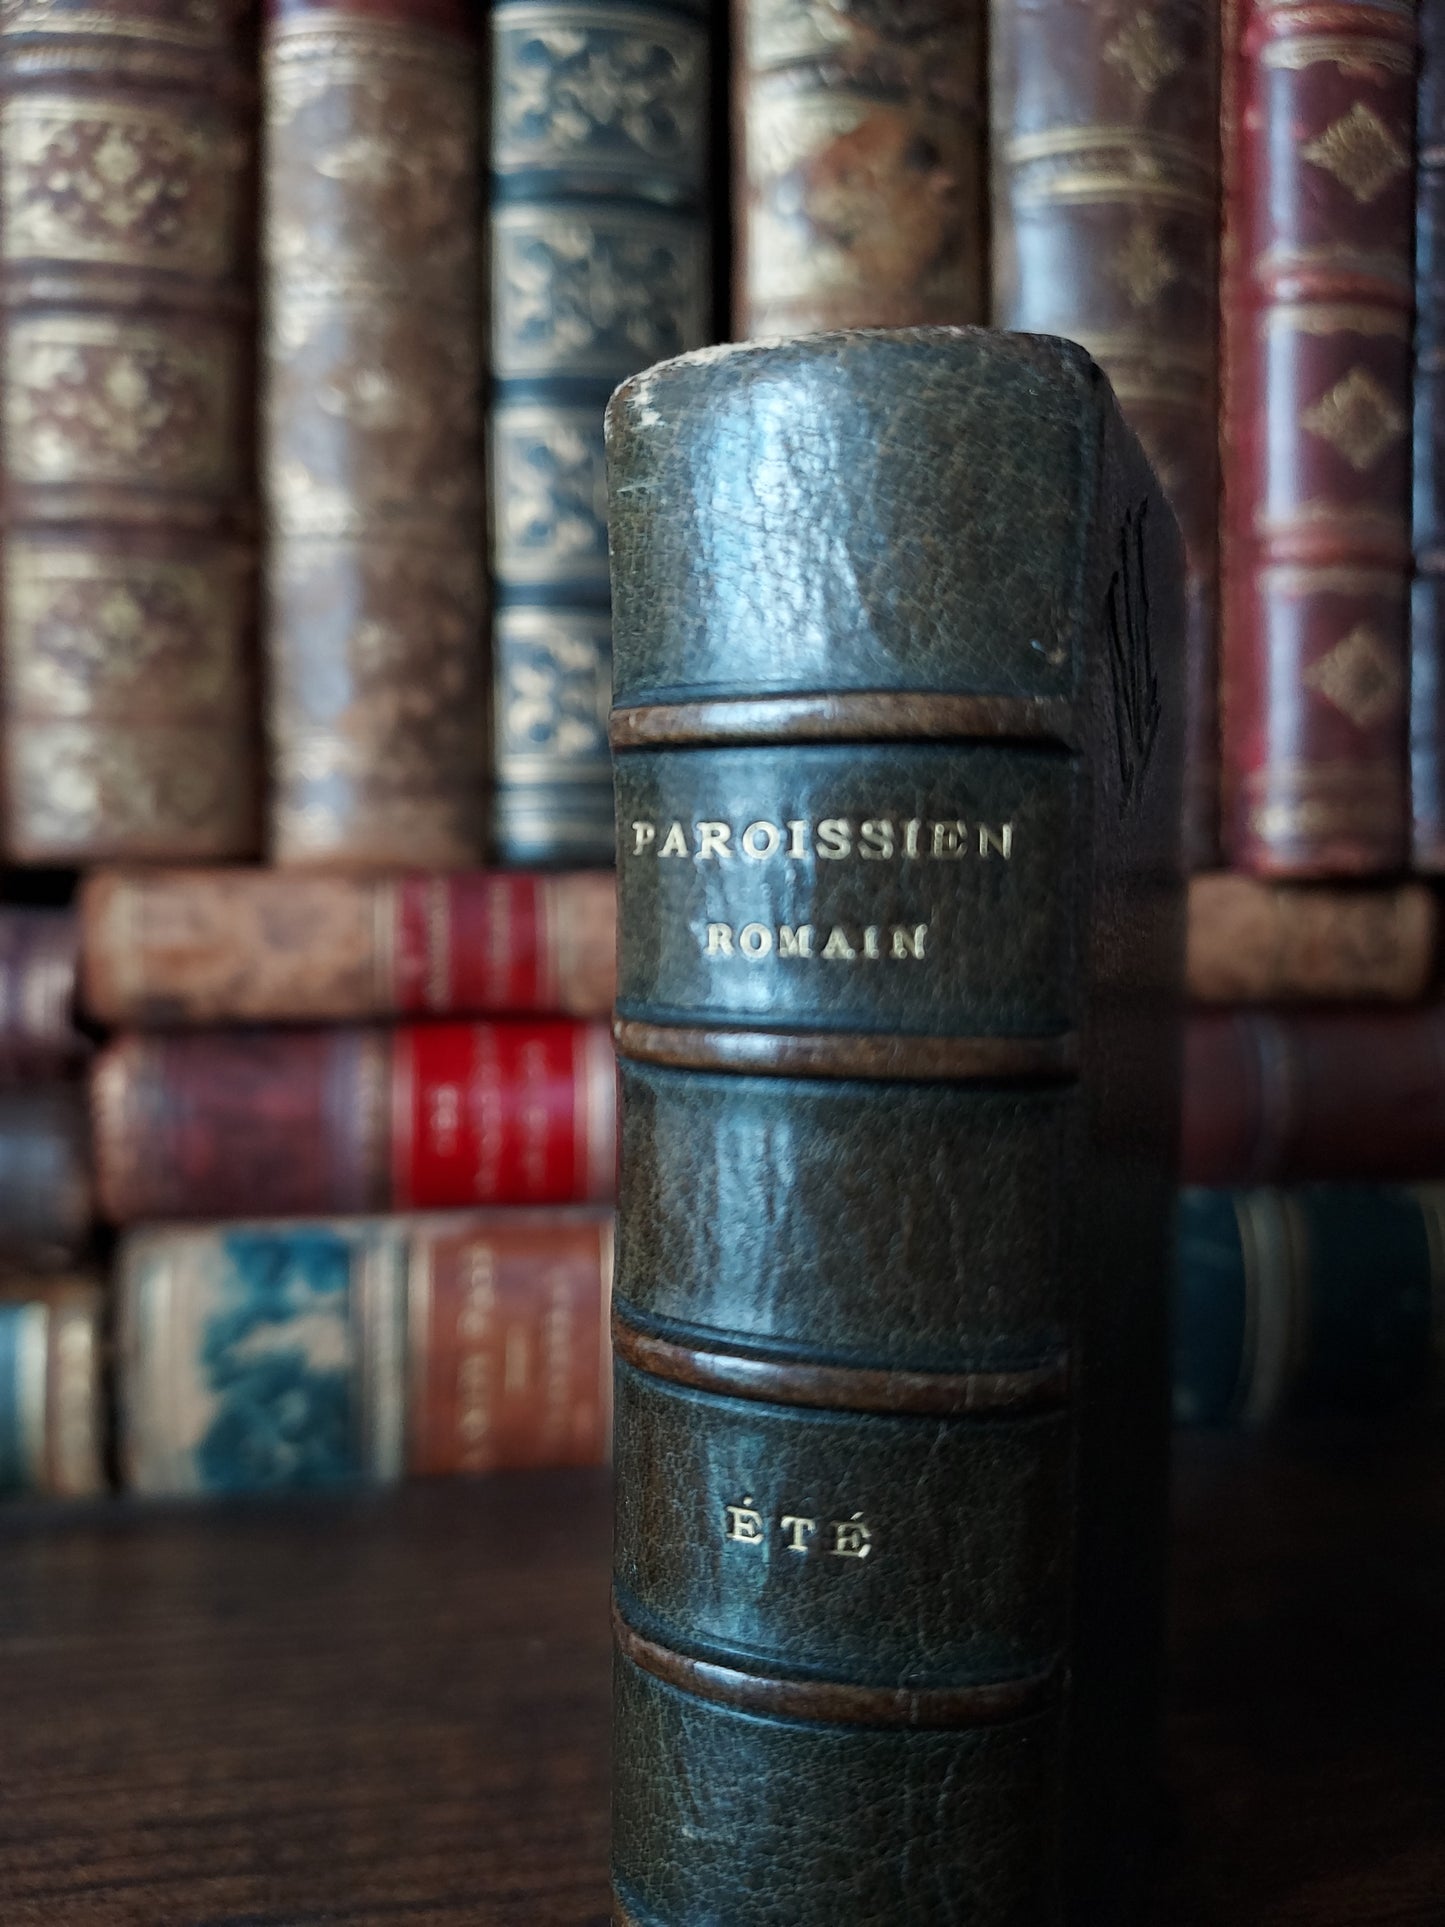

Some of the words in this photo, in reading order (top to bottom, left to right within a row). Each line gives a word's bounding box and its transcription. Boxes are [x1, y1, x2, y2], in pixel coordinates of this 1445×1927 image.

[631, 818, 1014, 860] PAROISSIEN
[702, 922, 929, 960] ROMAIN
[725, 1496, 873, 1559] ÉTÉ
